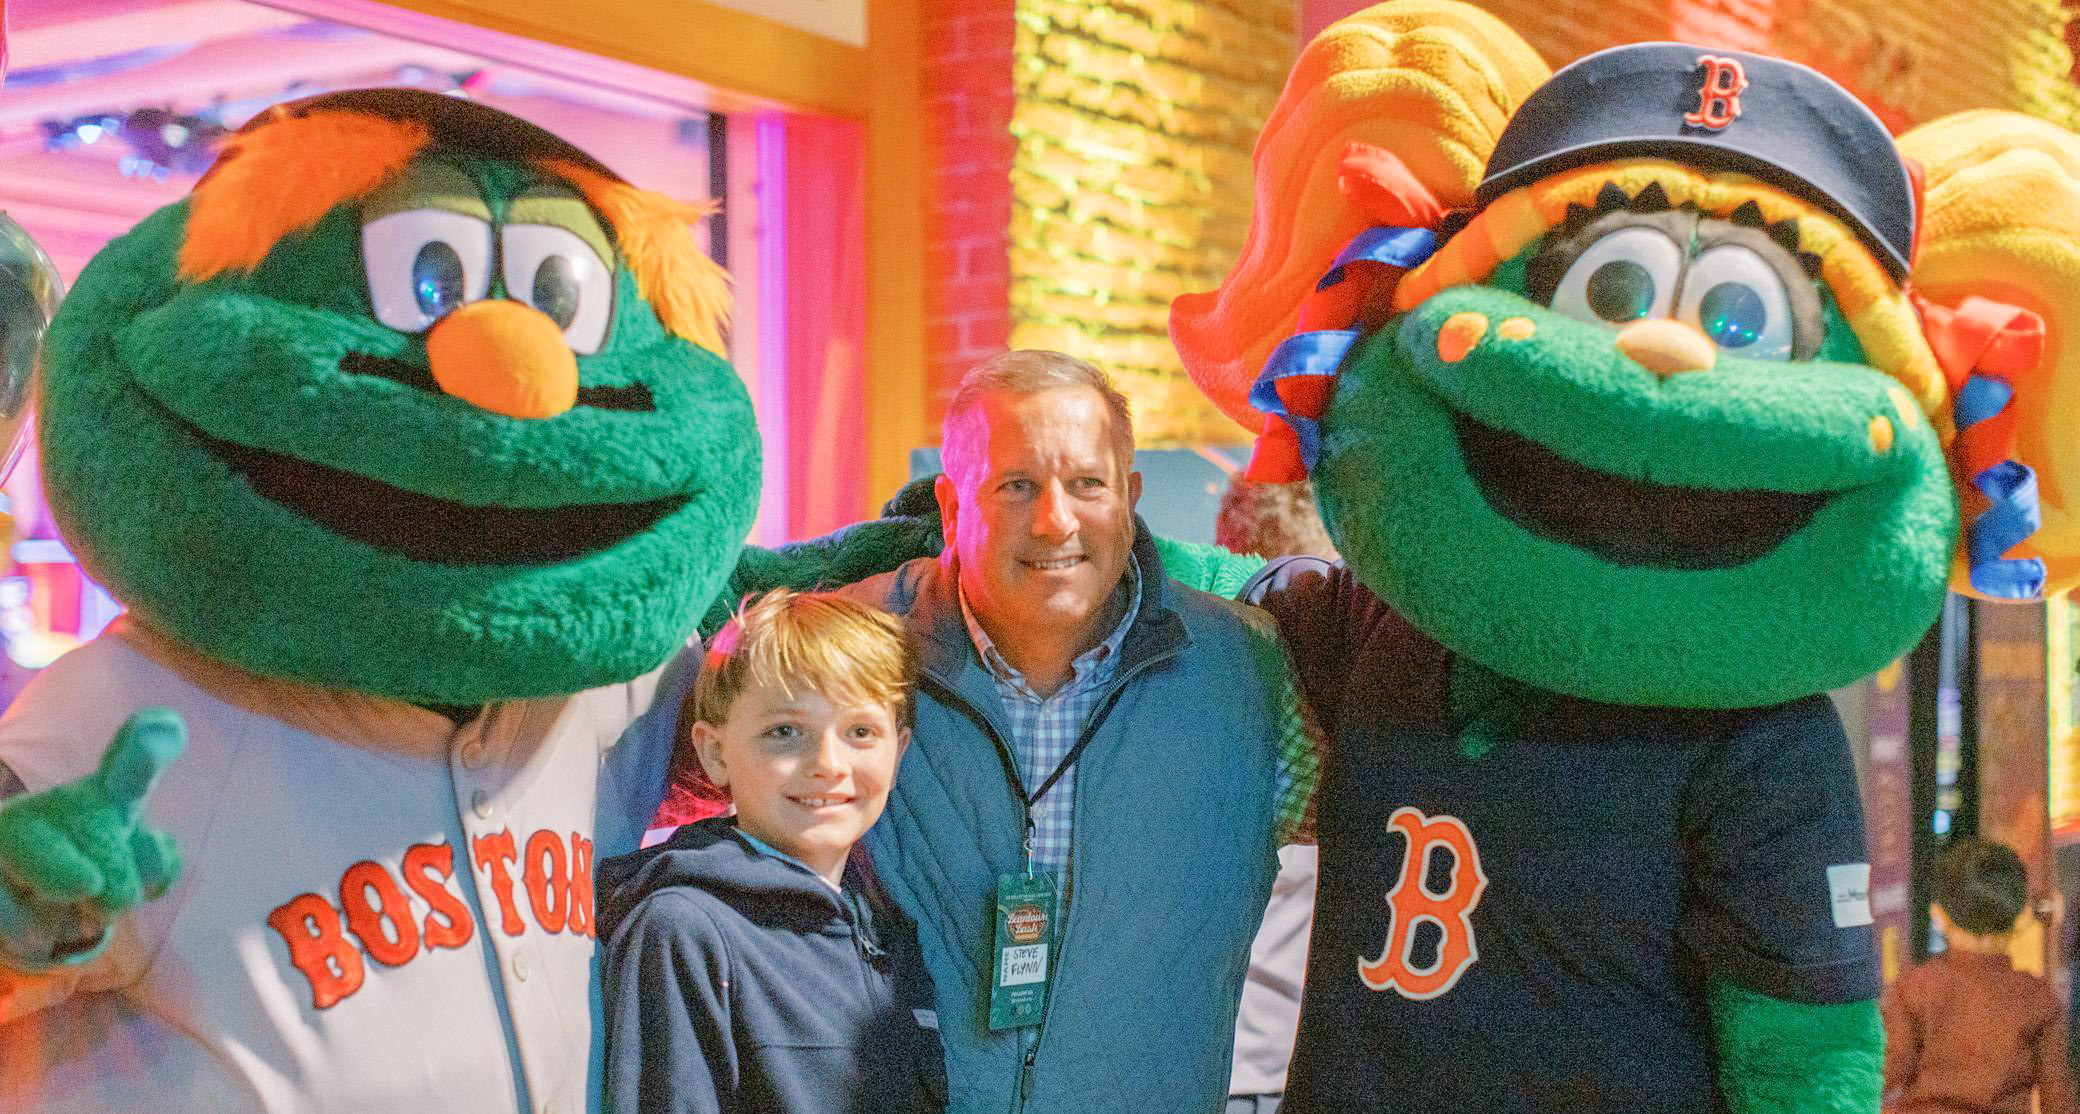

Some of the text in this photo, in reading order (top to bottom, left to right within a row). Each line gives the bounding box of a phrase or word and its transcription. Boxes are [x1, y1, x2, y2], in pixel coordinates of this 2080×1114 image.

[1683, 54, 1748, 129] B
[267, 826, 597, 1010] BOSTON
[1008, 910, 1048, 924] Beantown
[1358, 806, 1489, 1000] B
[1002, 951, 1010, 983] NAME
[1011, 956, 1043, 976] FLYNN
[1013, 946, 1039, 960] STEVE
